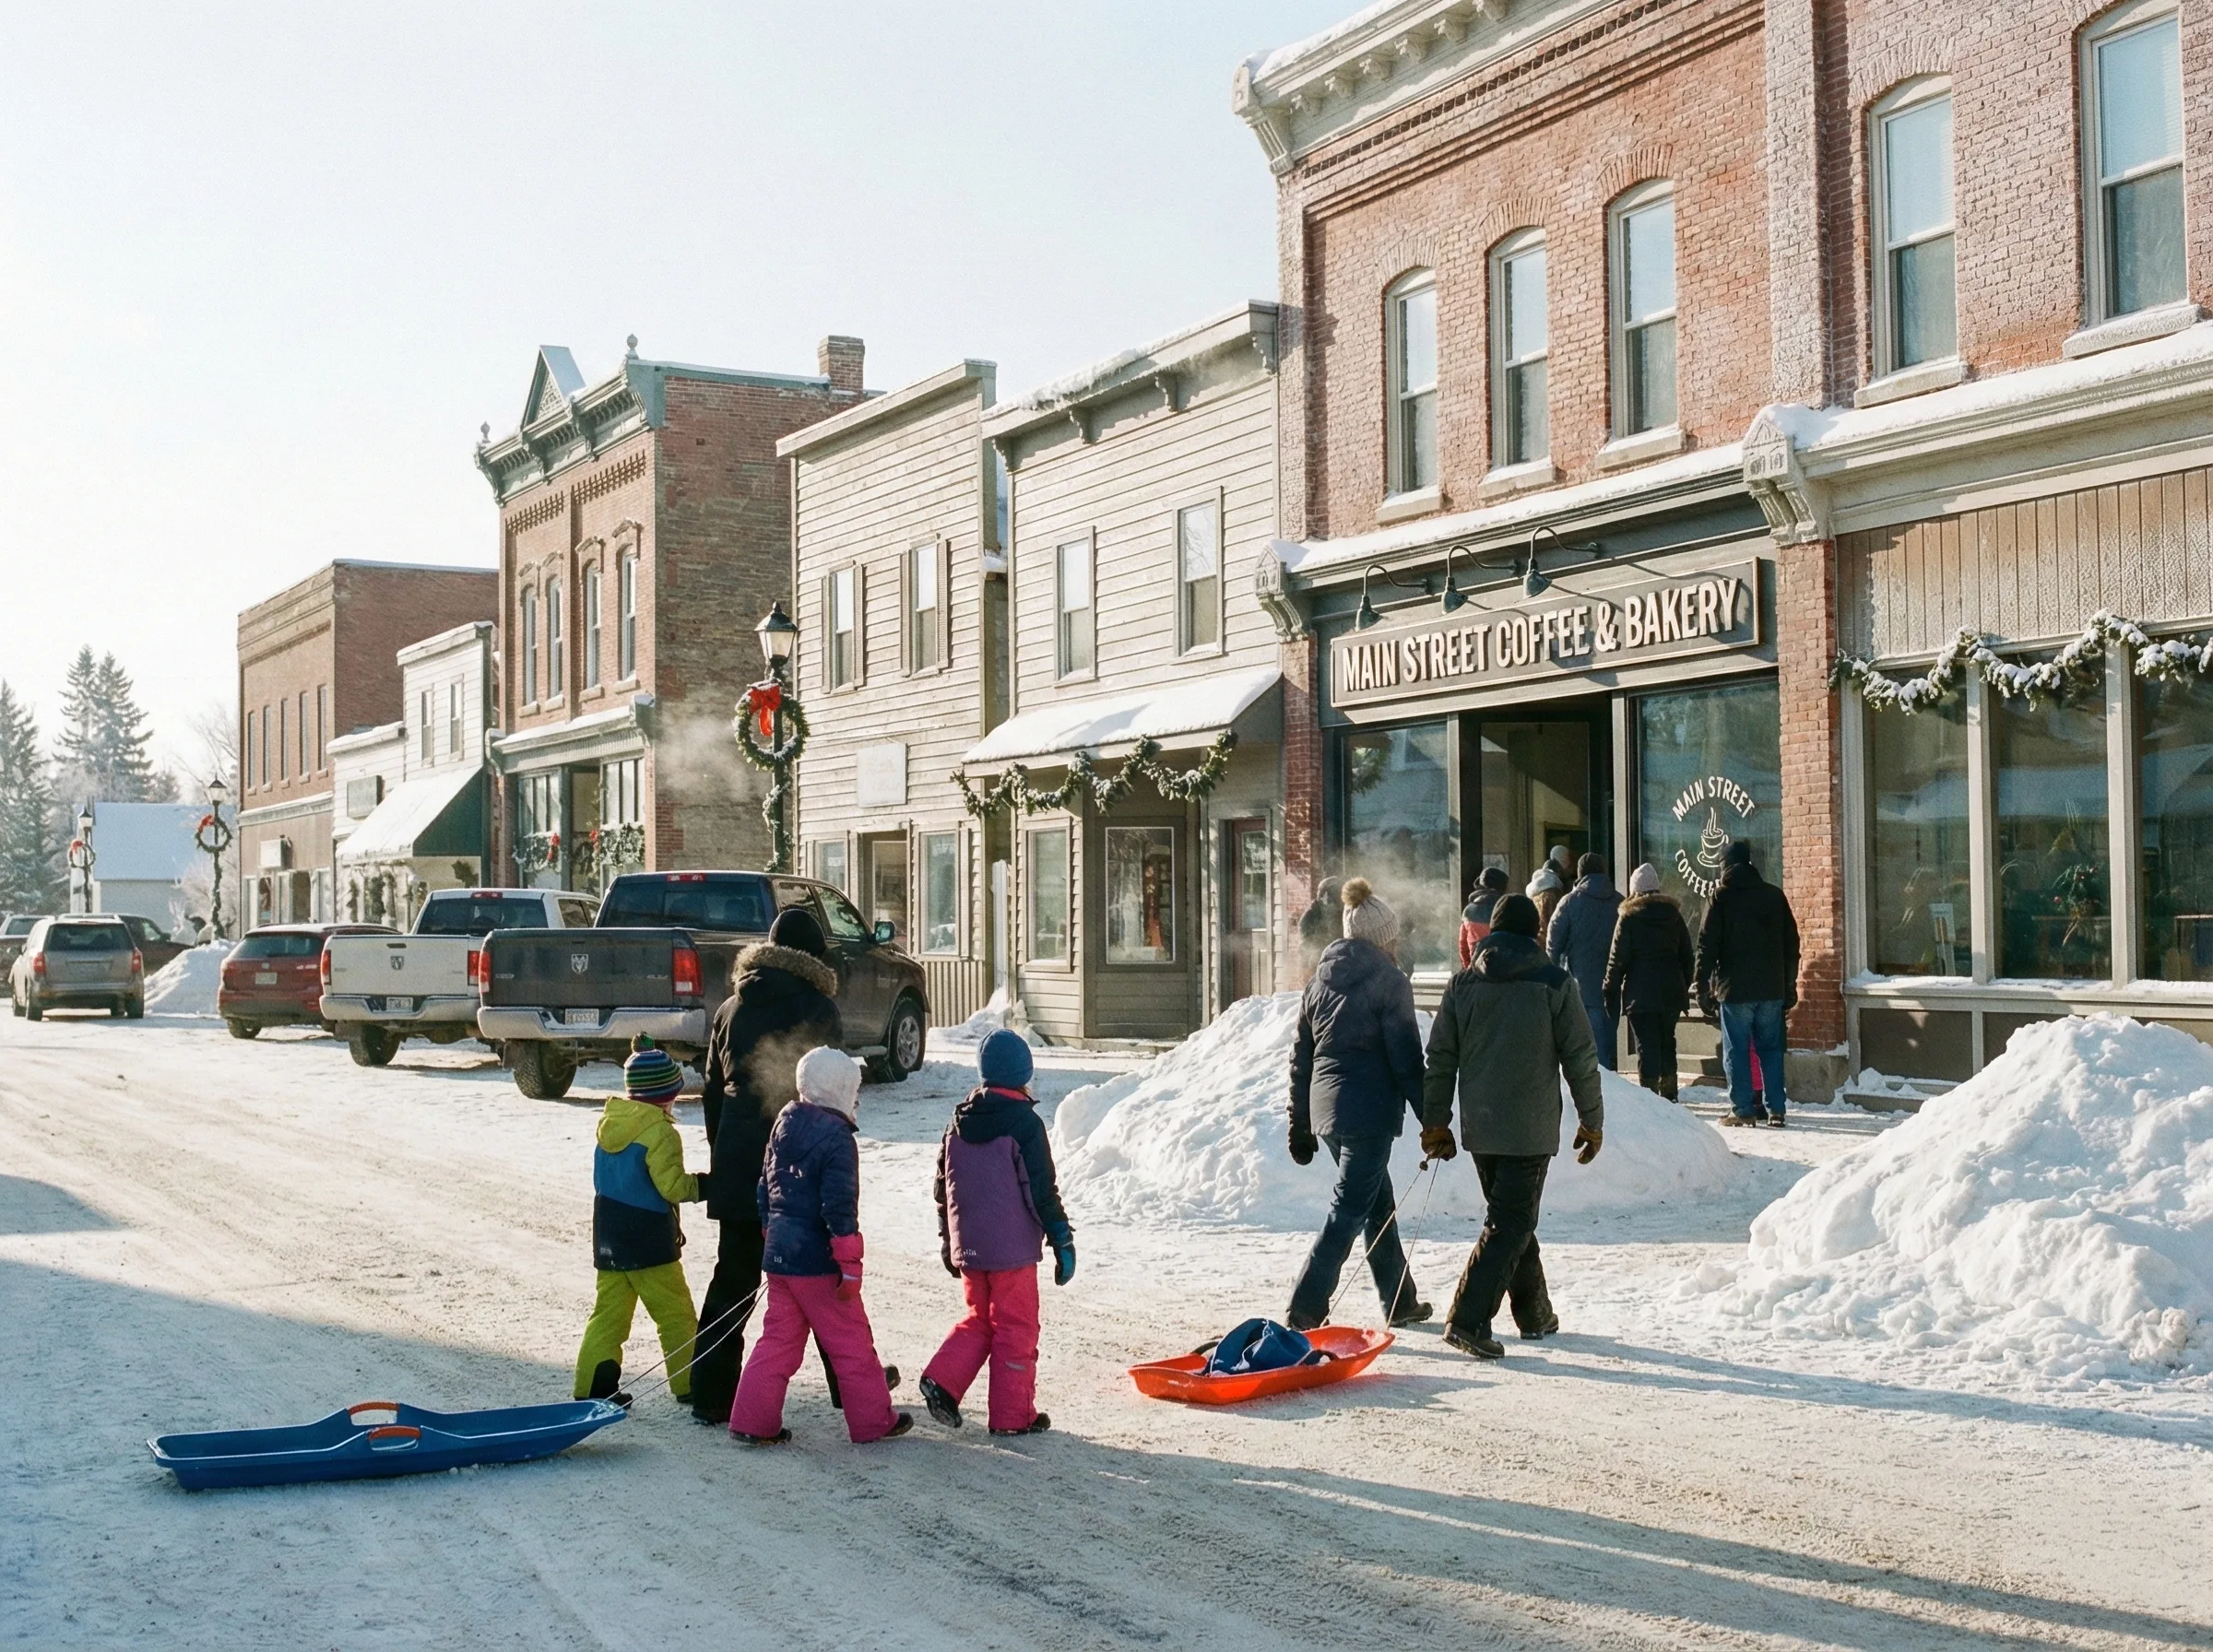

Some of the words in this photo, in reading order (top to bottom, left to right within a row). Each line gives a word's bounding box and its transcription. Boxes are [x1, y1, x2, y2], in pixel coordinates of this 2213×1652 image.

[1343, 639, 1398, 691] MAIN
[1403, 623, 1490, 683] STREET
[1497, 605, 1591, 668] COFFEE
[1594, 600, 1618, 653] &
[1625, 577, 1740, 649] BAKERY
[1672, 779, 1705, 822] MAIN
[1708, 775, 1755, 819] STREET
